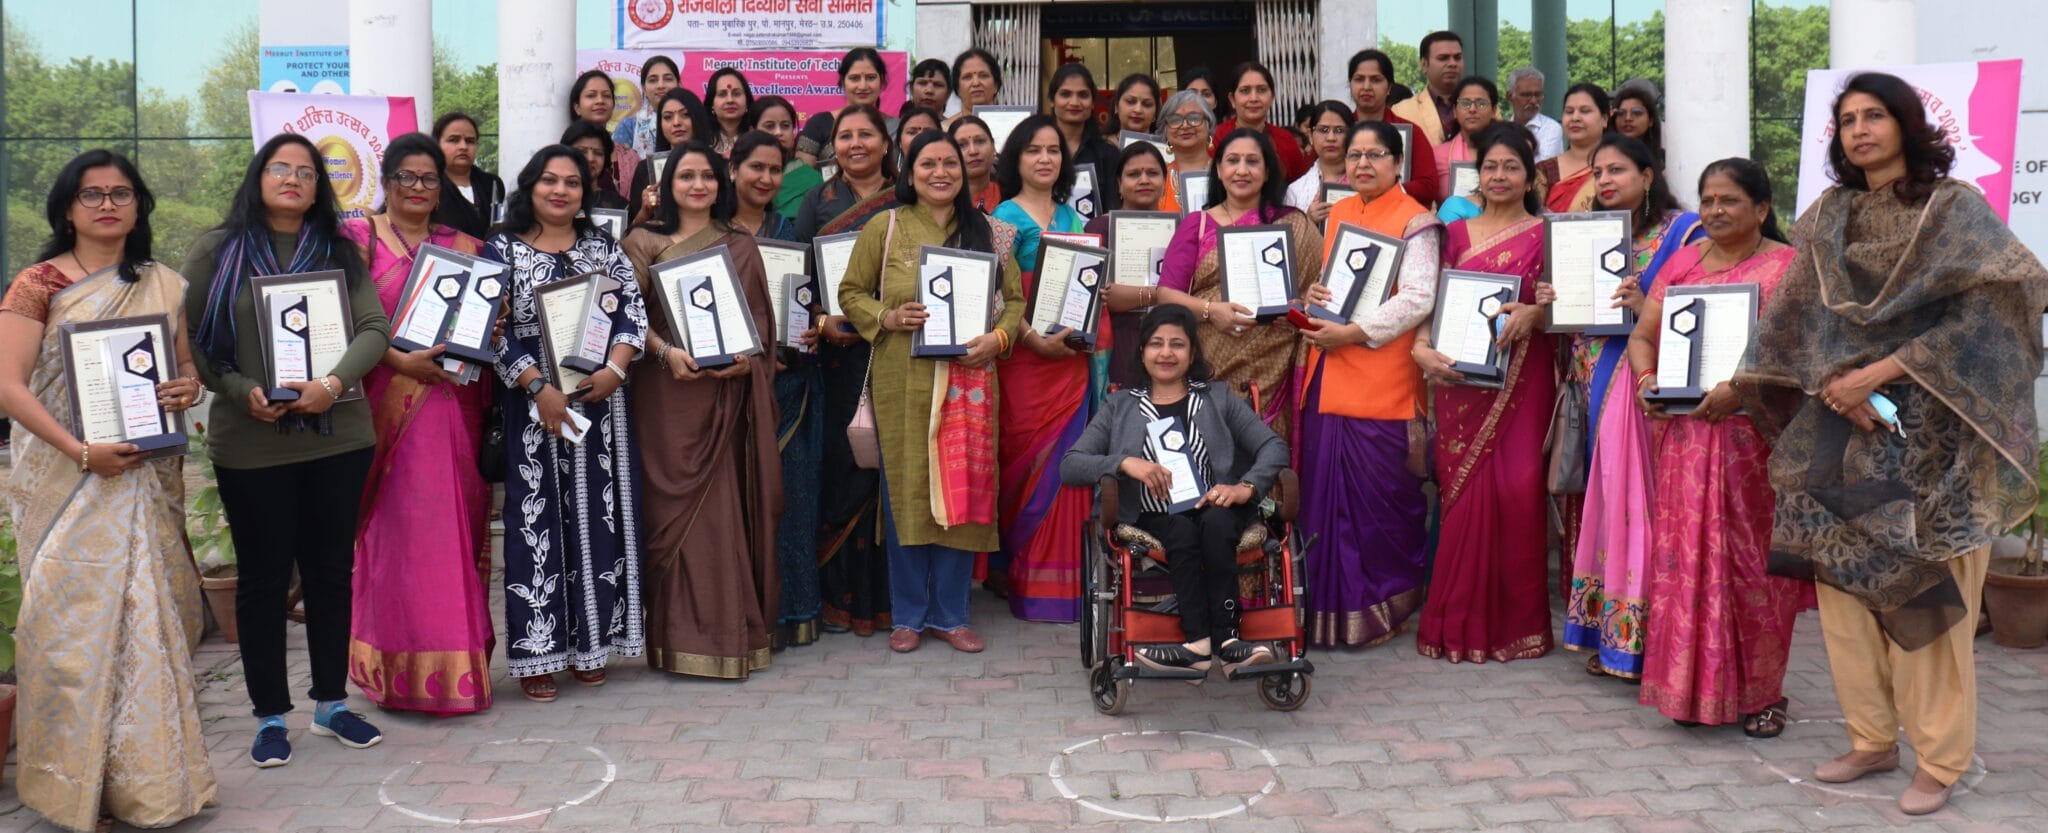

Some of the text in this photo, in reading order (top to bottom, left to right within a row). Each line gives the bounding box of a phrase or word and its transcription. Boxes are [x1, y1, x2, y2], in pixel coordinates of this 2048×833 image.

[837, 20, 863, 28] 250406
[286, 62, 323, 70] PROTECT
[704, 57, 842, 71] Meerut Institute of Tech
[301, 70, 319, 78] AND
[805, 84, 843, 95] Award
[2026, 160, 2048, 173] OF
